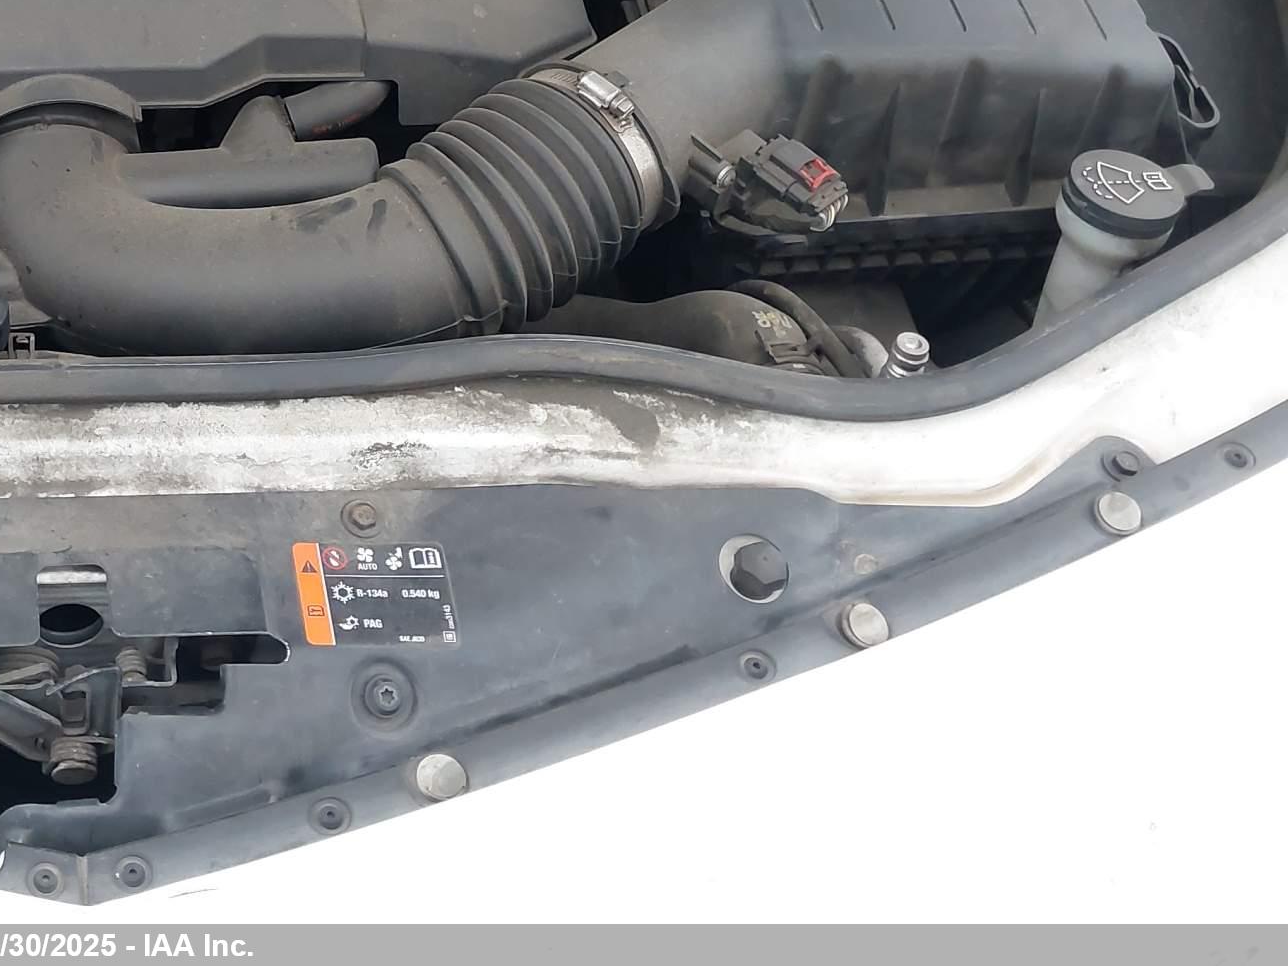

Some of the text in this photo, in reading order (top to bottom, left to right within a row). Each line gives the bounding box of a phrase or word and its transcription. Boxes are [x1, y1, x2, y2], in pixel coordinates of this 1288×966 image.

[357, 563, 378, 571] AUTO
[356, 588, 440, 600] R-134a 0.540 kg
[363, 618, 384, 629] PAG
